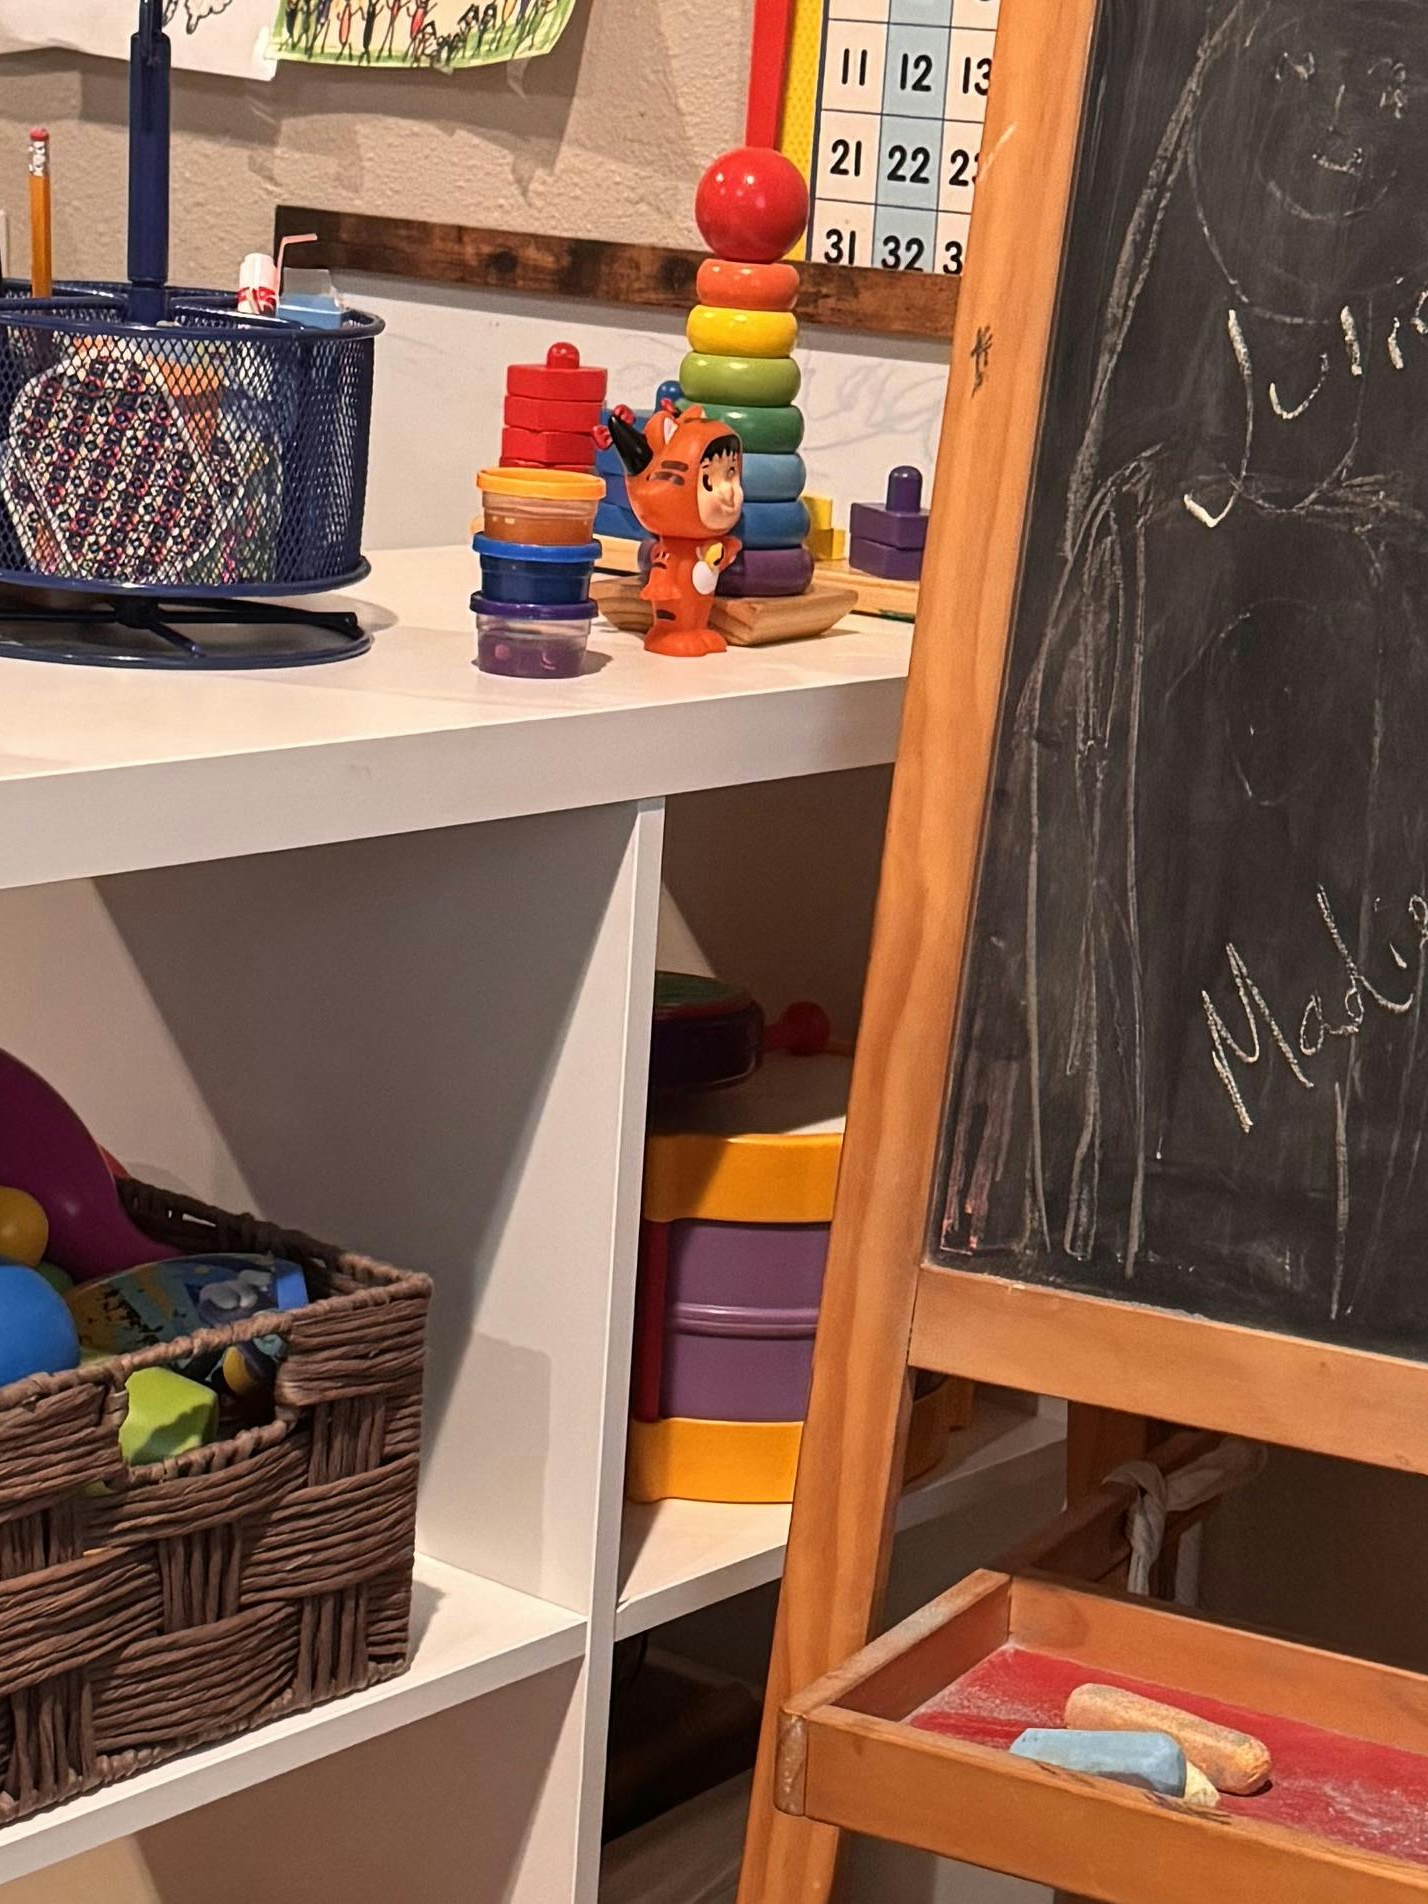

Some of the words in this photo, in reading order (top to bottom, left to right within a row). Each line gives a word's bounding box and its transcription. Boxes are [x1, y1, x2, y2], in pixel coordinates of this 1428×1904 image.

[840, 47, 869, 87] 11
[899, 52, 934, 93] 12
[829, 138, 863, 178] 21
[886, 144, 932, 185] 22
[947, 148, 981, 188] 2
[823, 228, 857, 266] 31
[880, 234, 925, 273] 32
